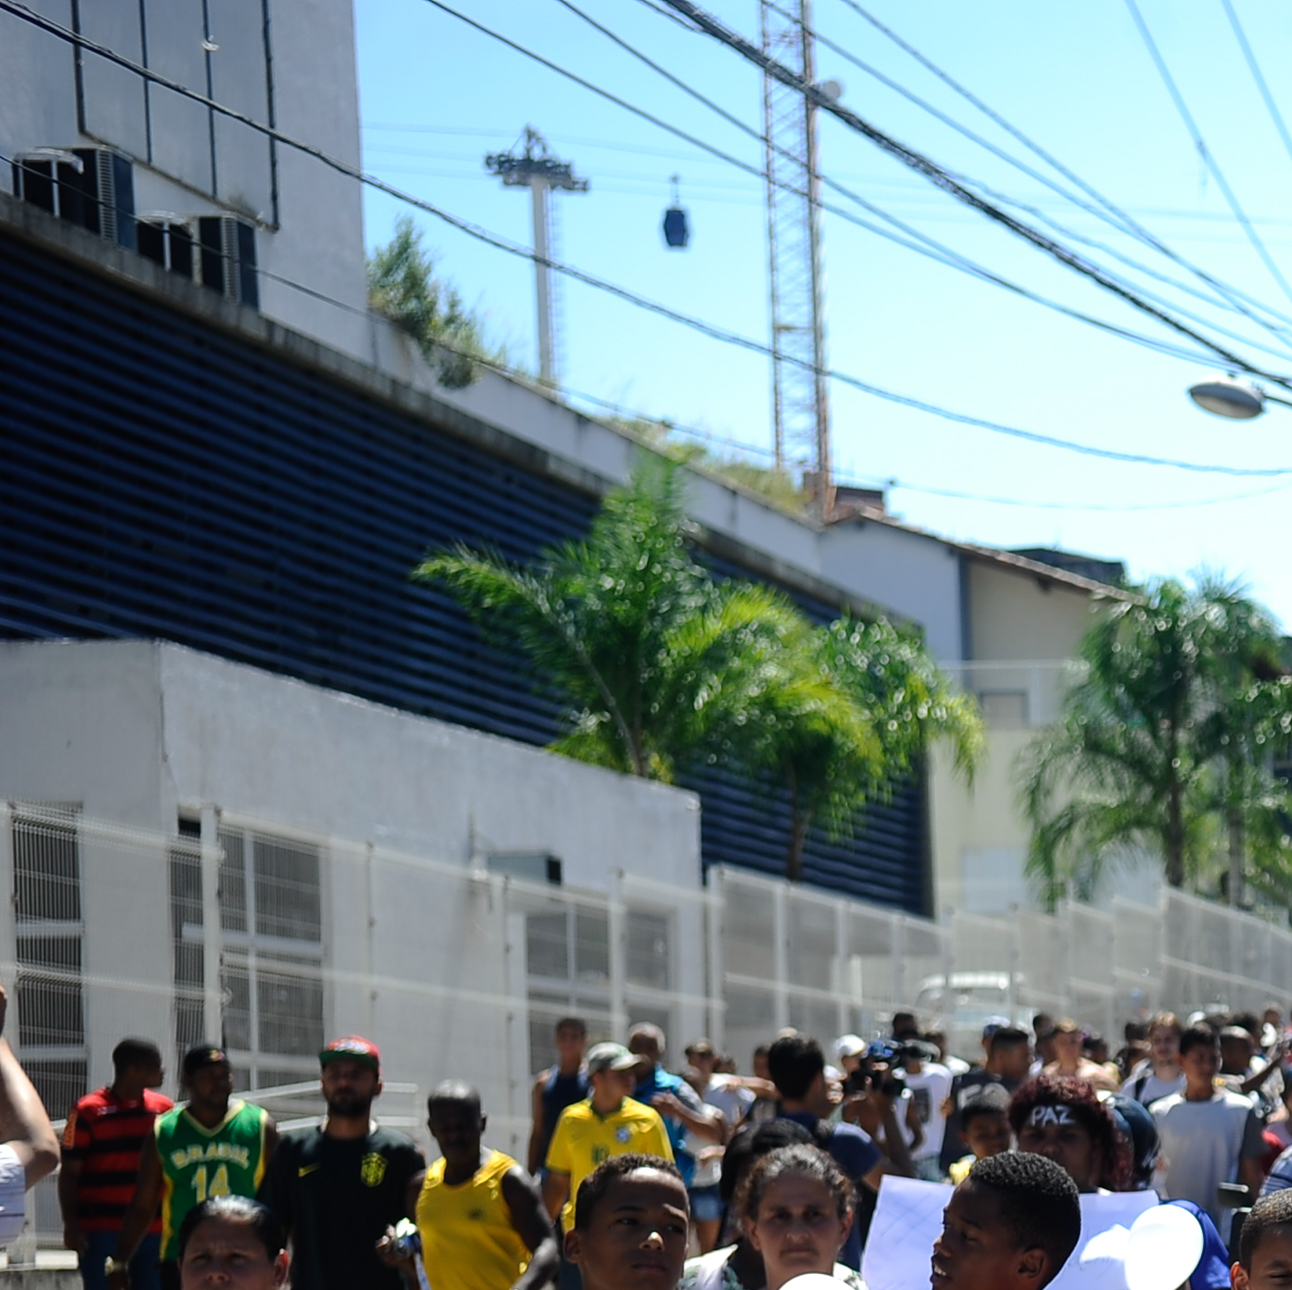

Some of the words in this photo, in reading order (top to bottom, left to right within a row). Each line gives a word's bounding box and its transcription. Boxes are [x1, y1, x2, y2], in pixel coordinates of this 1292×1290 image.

[1029, 1104, 1077, 1128] PAZ
[170, 1142, 250, 1170] BRASIL
[191, 1163, 232, 1203] 14
